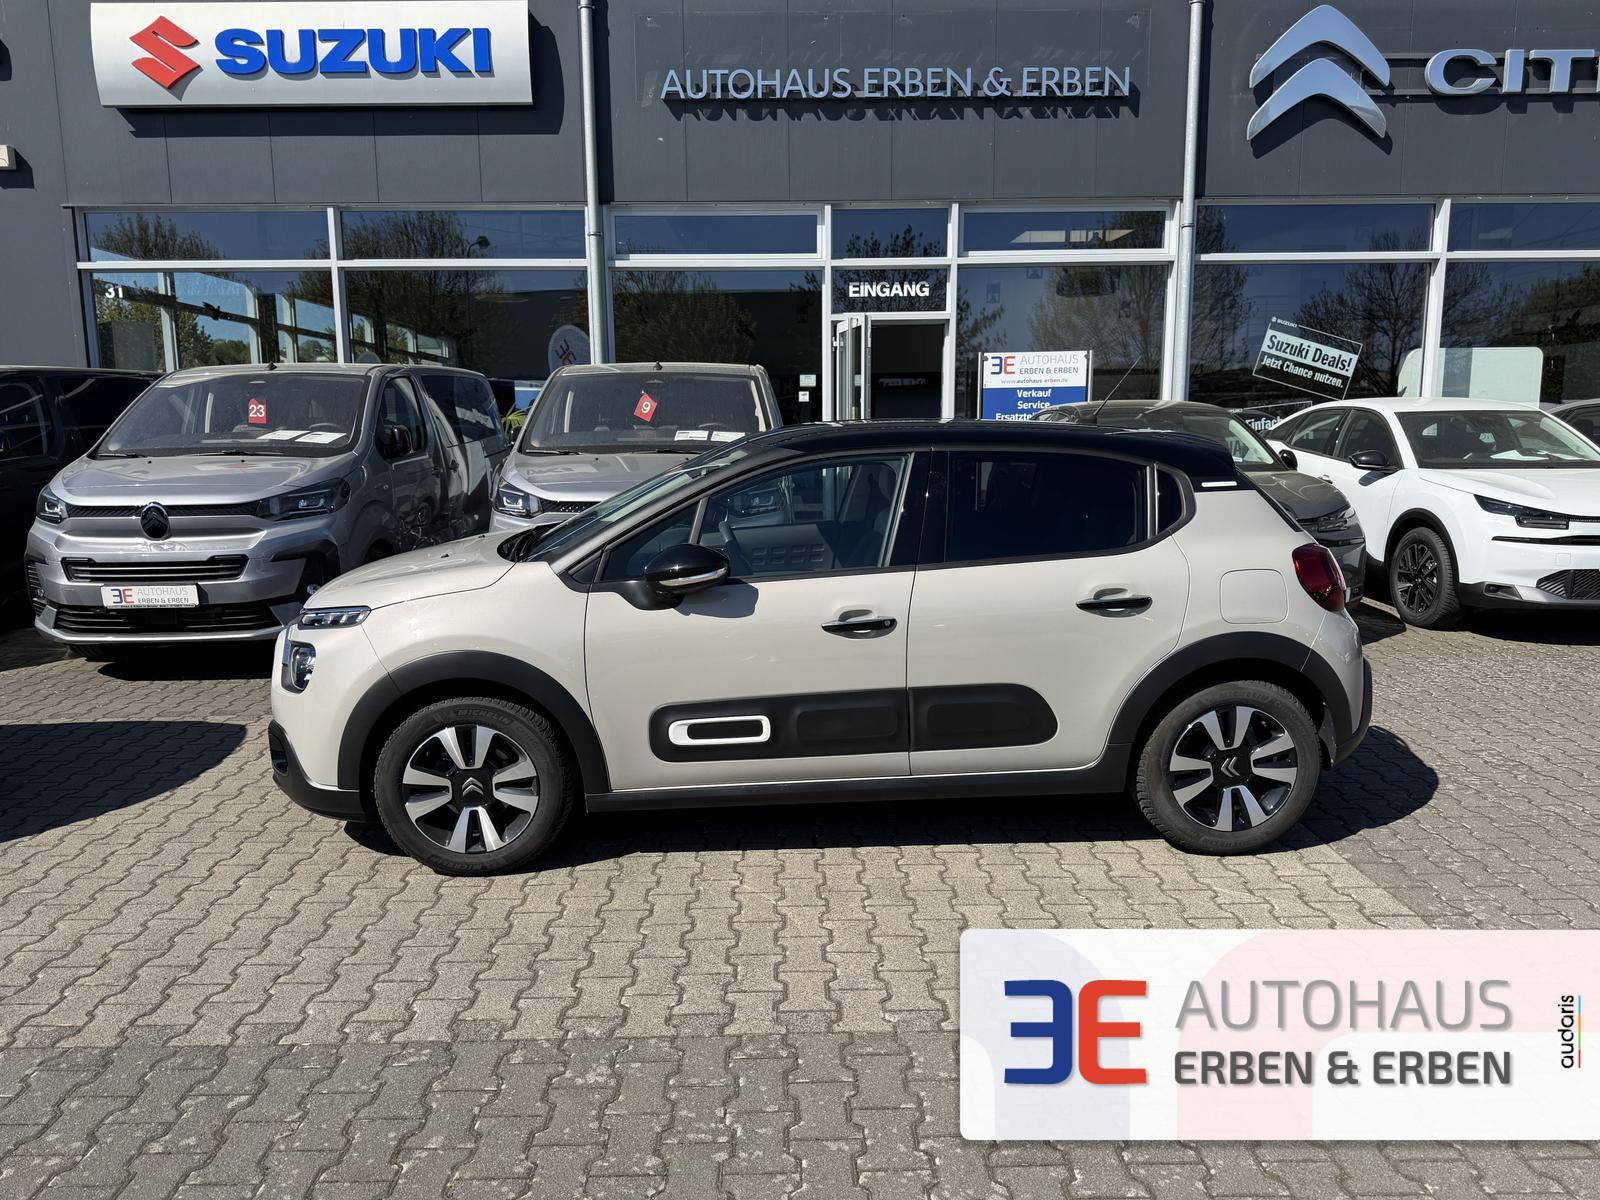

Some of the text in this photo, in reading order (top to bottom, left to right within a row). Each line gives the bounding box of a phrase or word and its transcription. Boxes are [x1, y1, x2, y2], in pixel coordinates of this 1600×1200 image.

[215, 27, 493, 76] SUZUKI
[1424, 49, 1600, 96] CIT
[661, 66, 1130, 100] AUTOHAUS ERBEN & ERBEN
[105, 284, 123, 298] 31
[848, 281, 930, 298] EINGANG
[1021, 354, 1078, 365] AUTOHAUS
[1267, 334, 1353, 372] Suzuki Deals!
[1261, 355, 1344, 388] Jetzt Chance nutzen.
[1016, 388, 1052, 398] Verkauf
[249, 404, 265, 418] 23
[641, 401, 651, 414] 9
[1017, 401, 1051, 410] Service
[995, 412, 1036, 421] Ersatzte
[137, 587, 188, 595] AUTOHAUS
